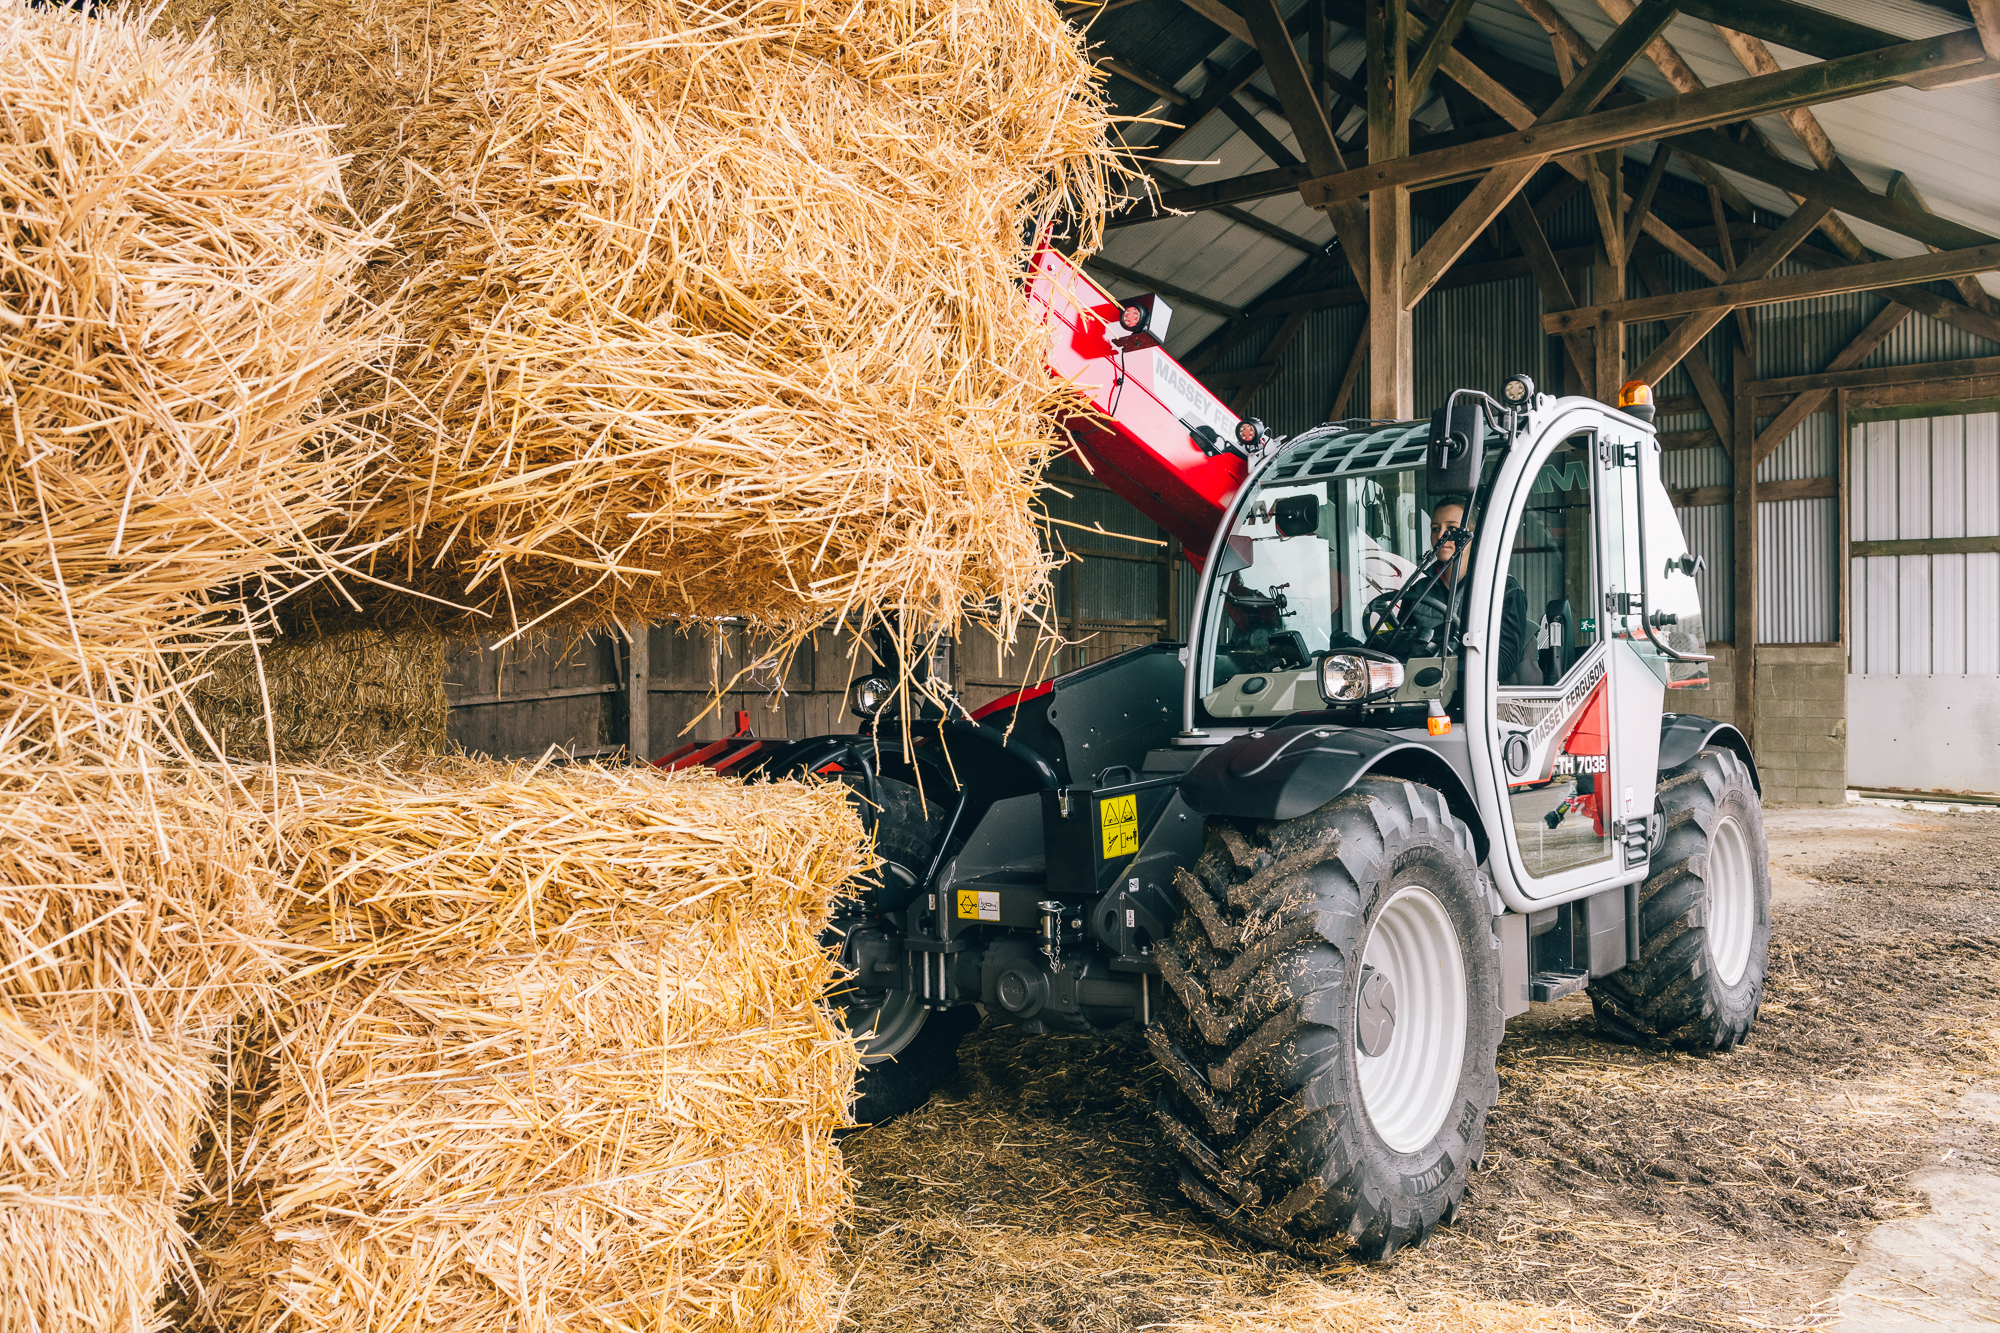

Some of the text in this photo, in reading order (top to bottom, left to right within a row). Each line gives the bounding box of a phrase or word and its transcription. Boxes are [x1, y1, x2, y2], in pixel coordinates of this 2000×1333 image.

[1155, 356, 1212, 416] MASSEY
[1530, 658, 1606, 752] MASSEY FERGUSON
[1557, 755, 1607, 775] TH 7038
[1409, 1161, 1446, 1197] XMCL
